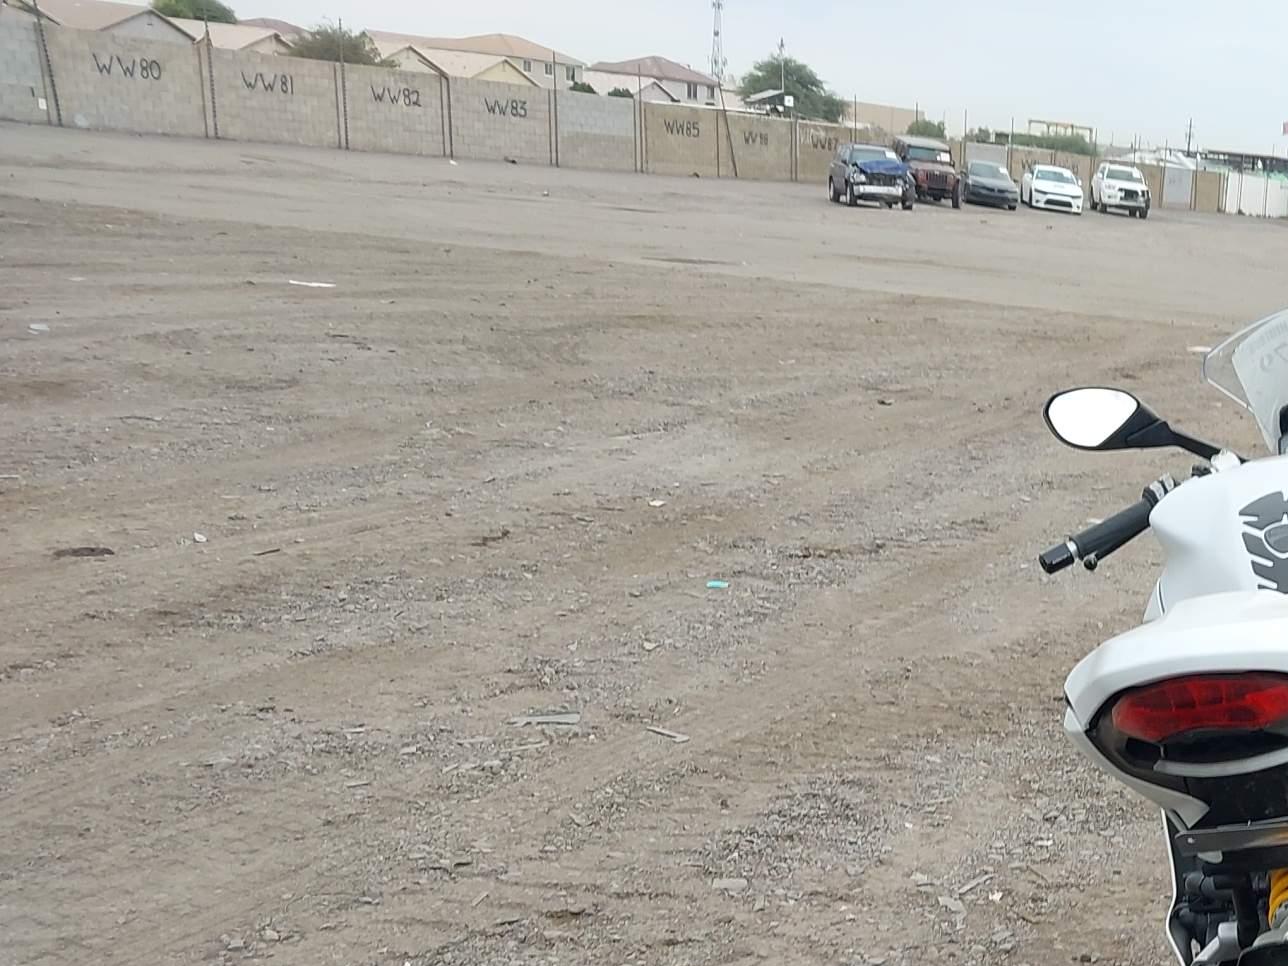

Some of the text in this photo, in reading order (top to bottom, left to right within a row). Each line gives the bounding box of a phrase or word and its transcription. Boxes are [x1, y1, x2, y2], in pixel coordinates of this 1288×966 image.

[93, 53, 162, 81] WW80
[241, 71, 294, 96] WW81
[371, 85, 422, 108] WW82
[484, 98, 528, 118] WW83
[663, 119, 700, 138] WW85
